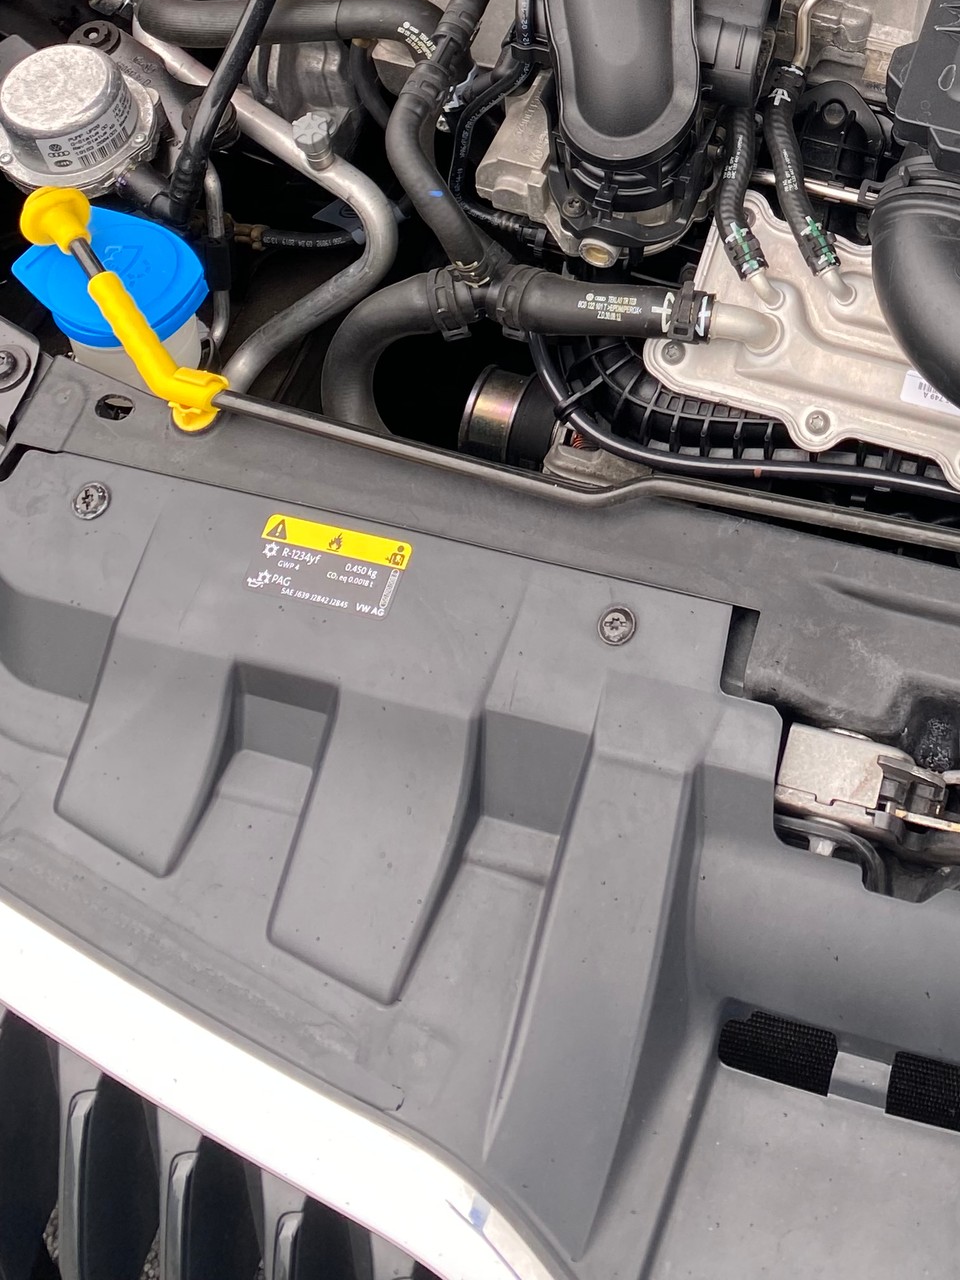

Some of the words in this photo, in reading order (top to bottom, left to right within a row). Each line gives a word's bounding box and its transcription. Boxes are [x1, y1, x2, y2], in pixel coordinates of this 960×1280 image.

[277, 560, 294, 569] GWP
[338, 574, 347, 583] eq
[347, 575, 369, 586] 0.0018
[280, 547, 321, 567] R-1234yf
[344, 563, 367, 574] 0.450
[366, 568, 377, 579] kg
[271, 574, 291, 586] PAG
[280, 587, 294, 596] SAE
[309, 594, 329, 604] J2842
[328, 598, 348, 608] J2845
[354, 602, 371, 613] VW
[370, 606, 385, 616] AG
